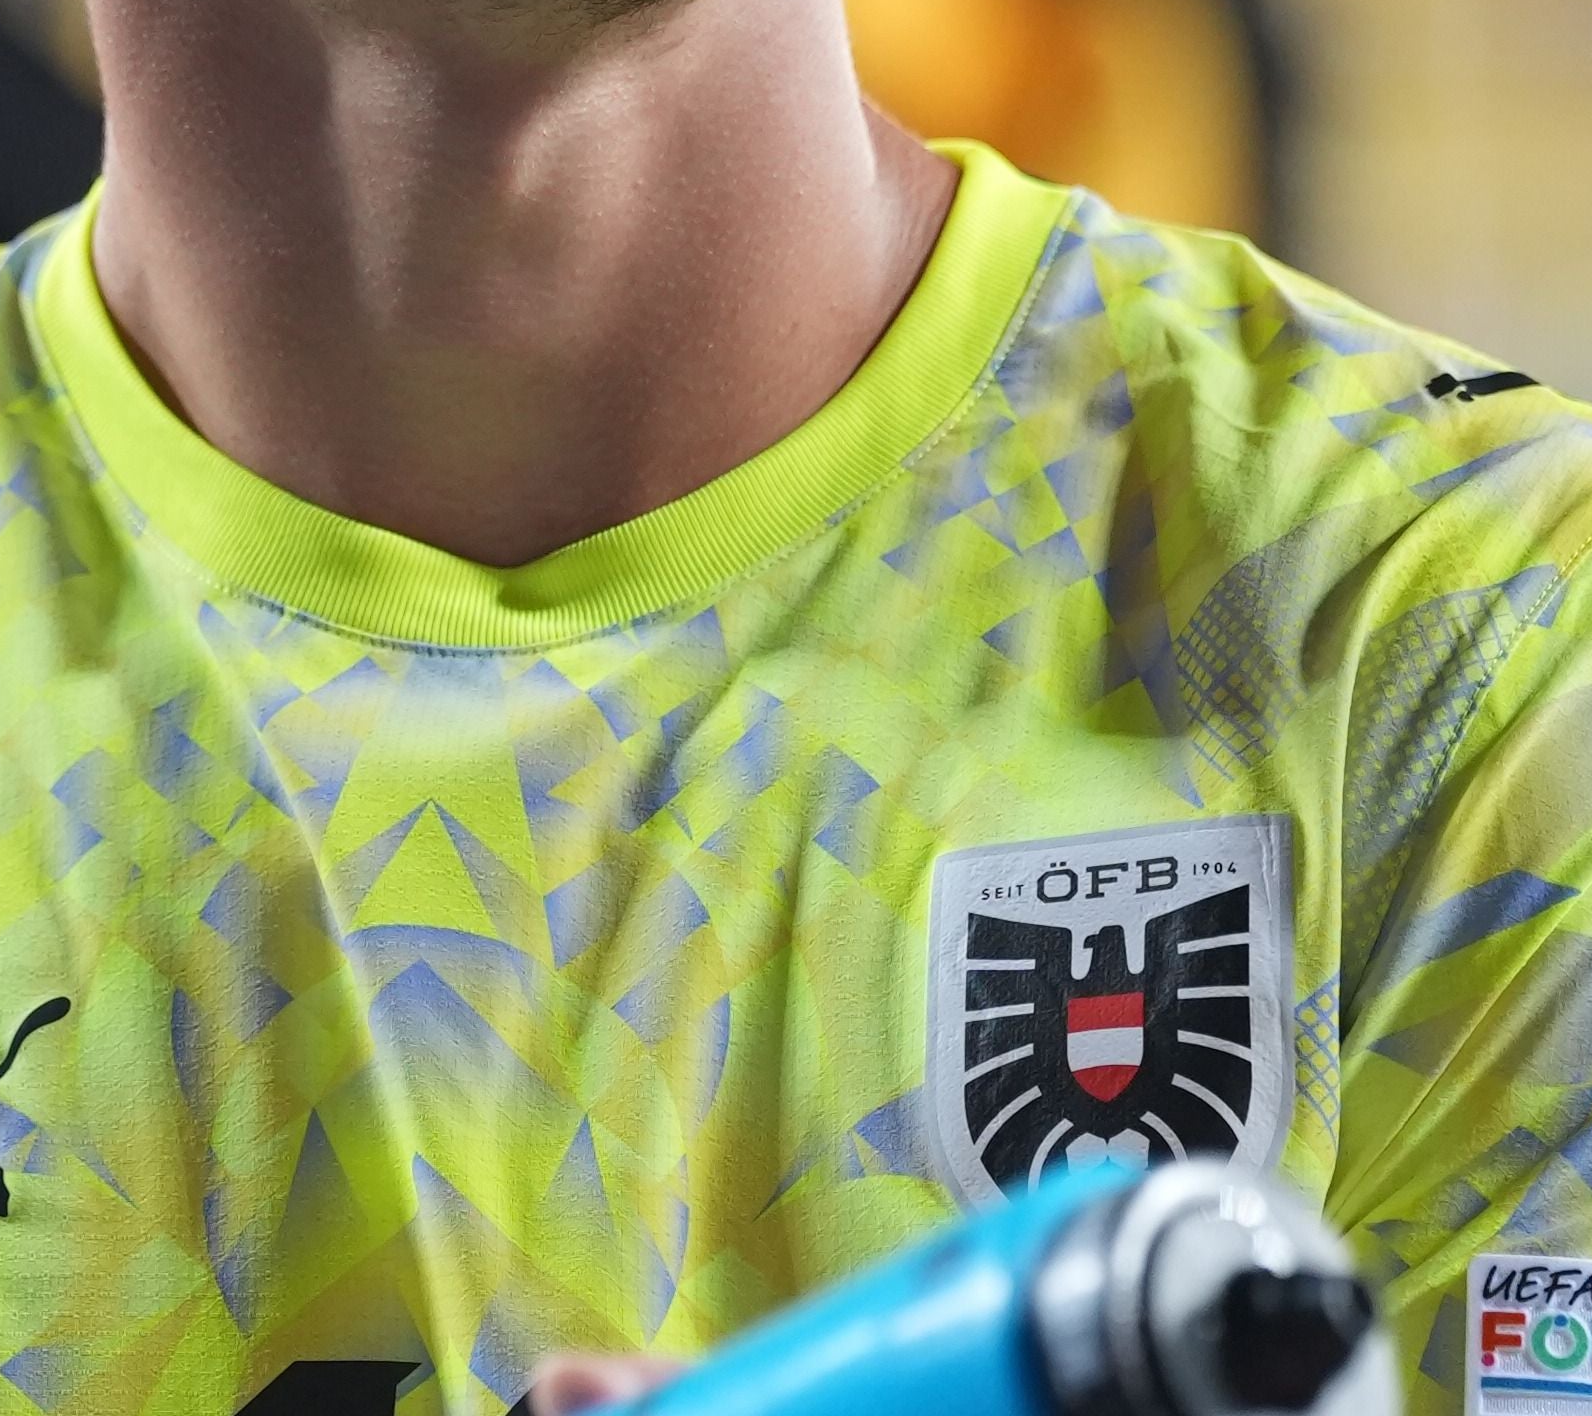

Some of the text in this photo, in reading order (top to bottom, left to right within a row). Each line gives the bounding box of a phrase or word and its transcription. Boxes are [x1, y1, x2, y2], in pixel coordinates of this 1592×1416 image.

[980, 855, 1238, 904] SEIT ÖFB 1904
